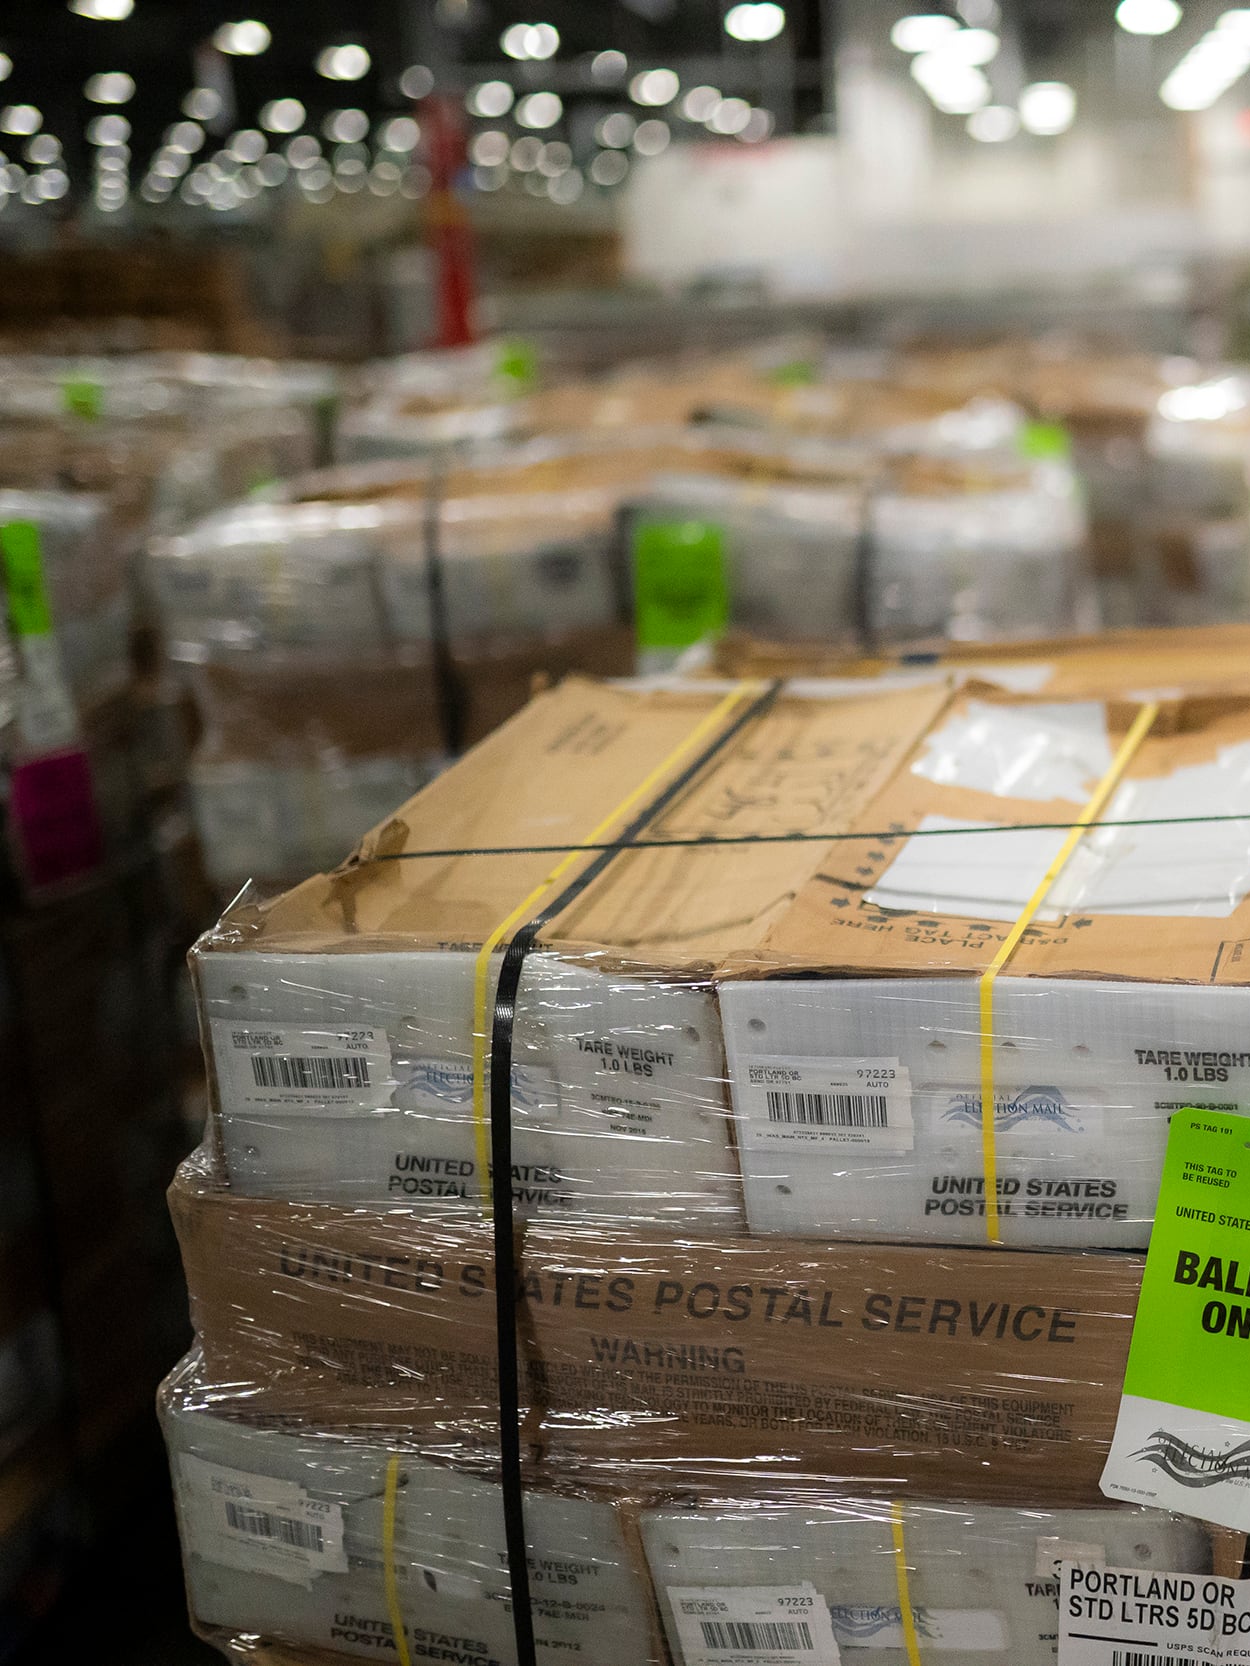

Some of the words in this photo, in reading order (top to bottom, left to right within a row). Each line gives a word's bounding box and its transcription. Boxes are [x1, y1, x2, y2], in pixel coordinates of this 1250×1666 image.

[904, 934, 984, 949] PLACE
[576, 1038, 613, 1055] TARE
[617, 1045, 675, 1066] WEIGHT
[1135, 1049, 1182, 1065] TARE
[601, 1058, 620, 1071] 1.0
[624, 1060, 653, 1077] LBS
[856, 1069, 896, 1079] 97223
[1164, 1067, 1188, 1081] 1.0
[1193, 1067, 1229, 1082] LBS
[1032, 1102, 1067, 1115] MAIL
[1190, 1122, 1200, 1130] PS
[1203, 1124, 1217, 1132] TAG
[394, 1154, 475, 1177] UNITED
[1184, 1161, 1205, 1173] THIS
[1207, 1166, 1224, 1177] TAG
[1226, 1169, 1238, 1179] TO
[388, 1175, 473, 1200] POSTAL
[1025, 1176, 1118, 1199] STATES
[1182, 1172, 1195, 1183] BE
[1196, 1175, 1230, 1189] REUSED
[1023, 1201, 1130, 1220] SERVICE
[1175, 1206, 1216, 1224] UNITED
[280, 1246, 444, 1292] UNITED
[459, 1262, 635, 1312] SATES
[654, 1281, 843, 1328] POSTAL
[861, 1292, 1077, 1345] SERVICE
[590, 1336, 746, 1374] WARNING
[638, 1370, 661, 1383] THE
[665, 1373, 740, 1391] PERMISSION
[743, 1379, 760, 1391] OF
[765, 1381, 788, 1393] THE
[971, 1396, 998, 1411] THIS
[1002, 1399, 1075, 1417] EQUIPMENT
[712, 1401, 769, 1418] MONITOR
[773, 1406, 796, 1419] THE
[800, 1408, 862, 1424] LOCATION
[865, 1414, 880, 1427] OF
[737, 1391, 812, 1408] PROHIBITED
[815, 1397, 831, 1410] BY
[835, 1398, 889, 1416] FEDERAL
[955, 1409, 1001, 1423] POSTAL
[539, 1559, 601, 1577] WEIGHT
[548, 1572, 579, 1586] LBS
[1070, 1568, 1195, 1602] PORTLAND
[1202, 1581, 1236, 1609] OR
[777, 1597, 814, 1607] 97223
[788, 1608, 809, 1616] AUTO
[1069, 1595, 1113, 1621] STD
[1121, 1601, 1180, 1628] LTRS
[1186, 1606, 1216, 1632] 5D
[334, 1613, 409, 1637] UNITE
[414, 1628, 489, 1654] STATES
[331, 1627, 398, 1651] POSTA
[414, 1643, 501, 1666] SERVICE
[1166, 1642, 1193, 1654] USPS
[1196, 1646, 1224, 1659] SCAN
